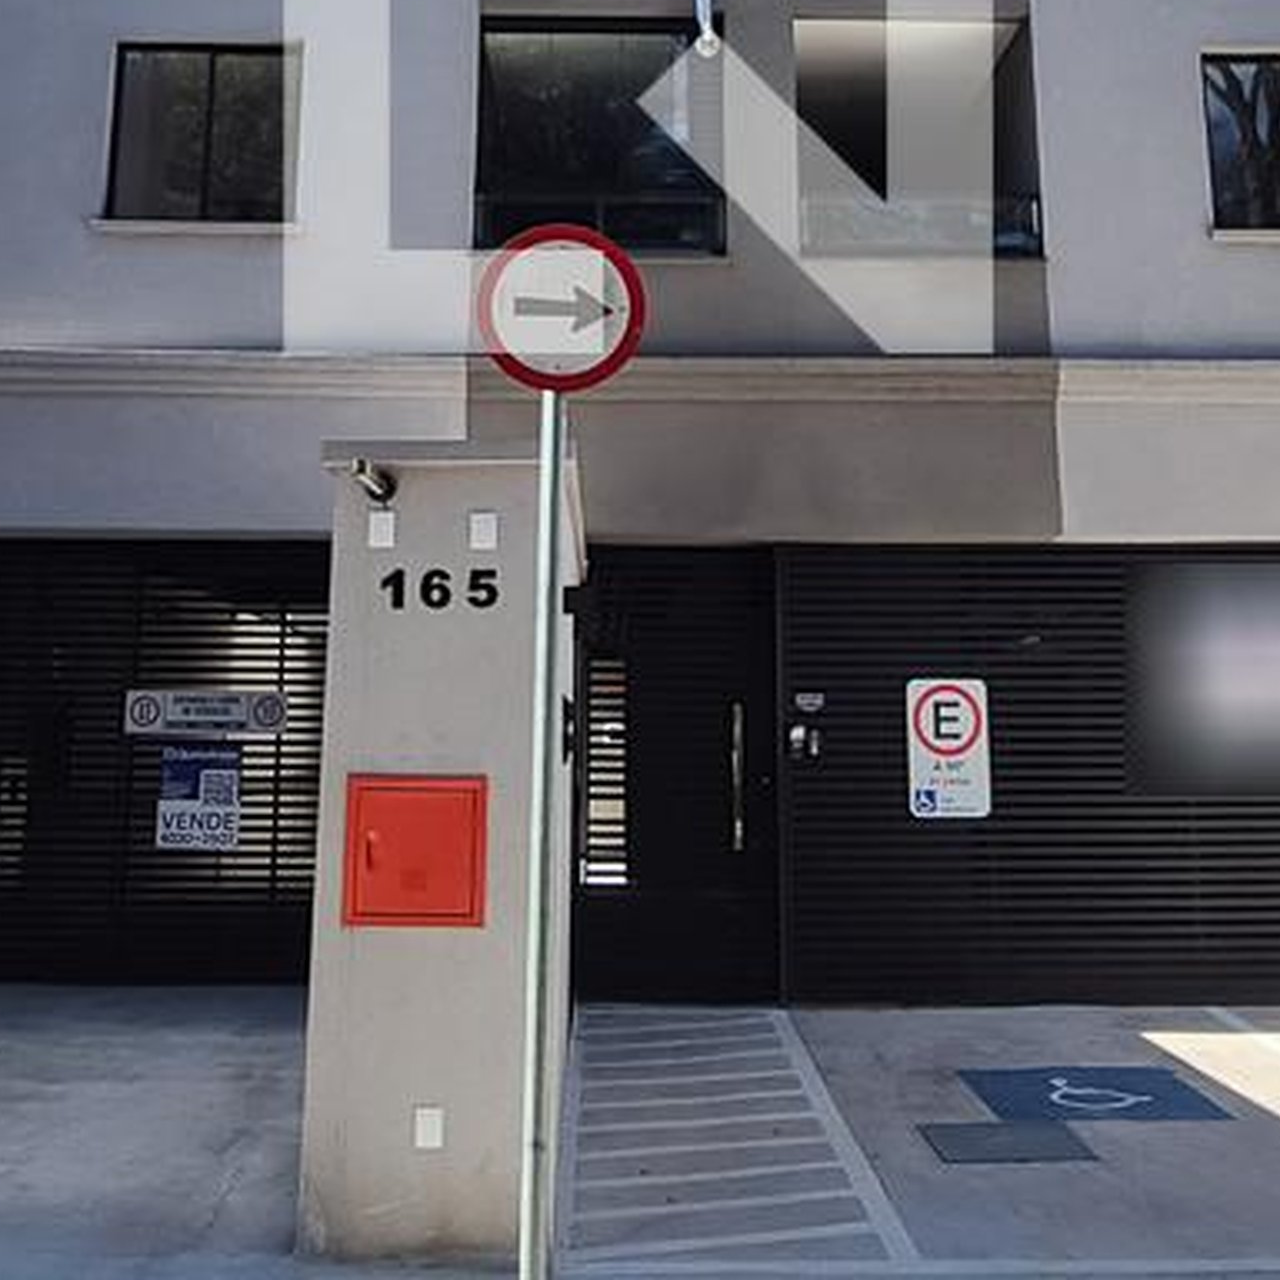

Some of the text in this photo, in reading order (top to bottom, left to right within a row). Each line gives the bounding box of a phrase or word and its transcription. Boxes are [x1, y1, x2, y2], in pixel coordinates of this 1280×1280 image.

[381, 569, 499, 609] 165
[933, 701, 961, 740] E
[162, 812, 236, 831] VENDE
